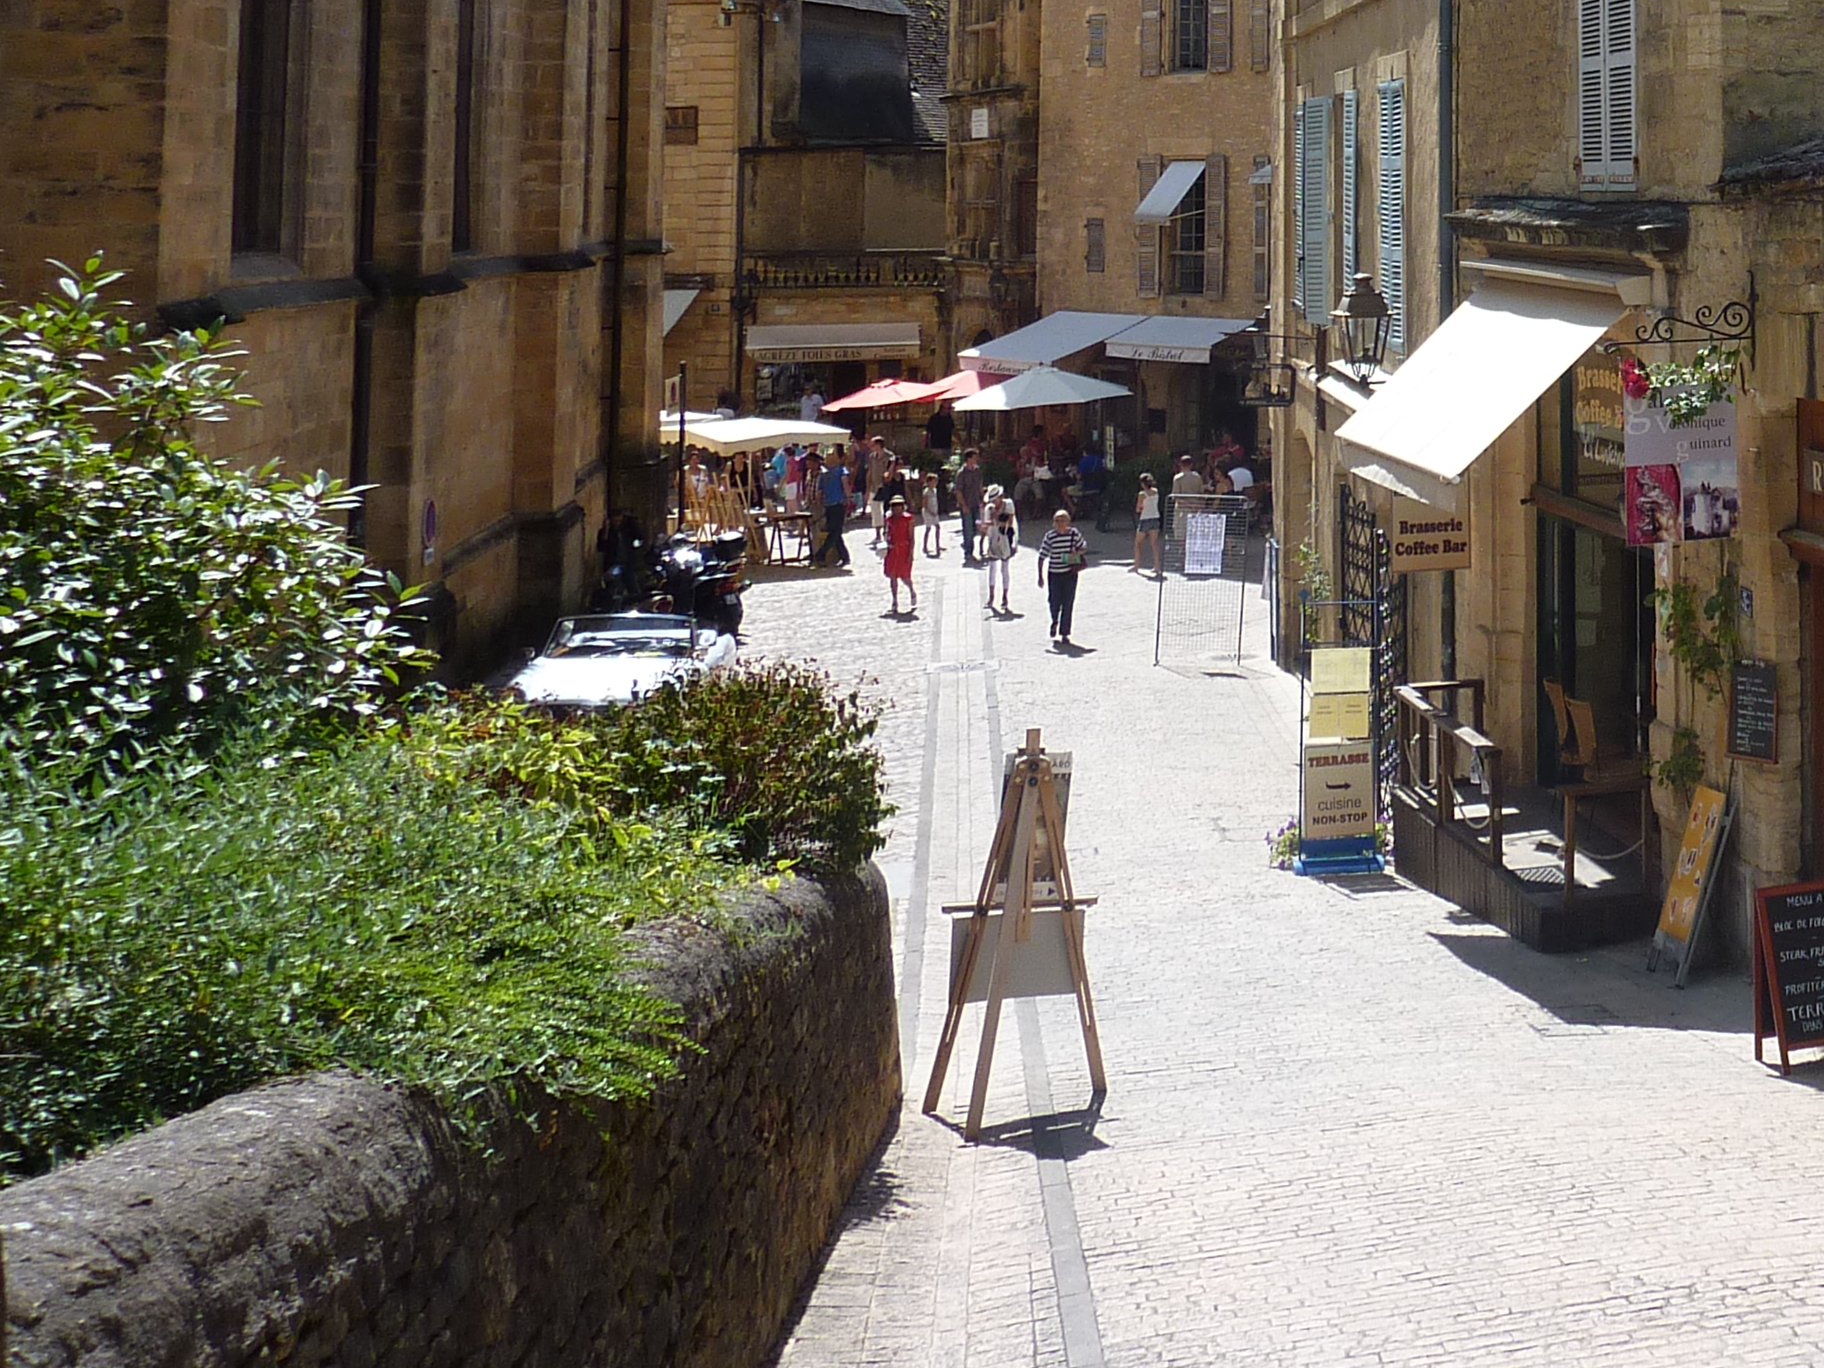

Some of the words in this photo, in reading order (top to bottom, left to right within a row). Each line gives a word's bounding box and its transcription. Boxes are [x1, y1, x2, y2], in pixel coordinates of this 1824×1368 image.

[1614, 404, 1624, 429] B
[1676, 436, 1732, 463] guinard
[1399, 518, 1463, 535] Brasserie
[1395, 541, 1439, 556] Coffee
[1442, 539, 1467, 554] Bar
[1307, 752, 1370, 768] TERRASSE
[1317, 796, 1361, 811] cuisine
[1312, 812, 1368, 826] NON-STOP
[1786, 894, 1813, 907] MENU
[1802, 1018, 1824, 1033] DANS
